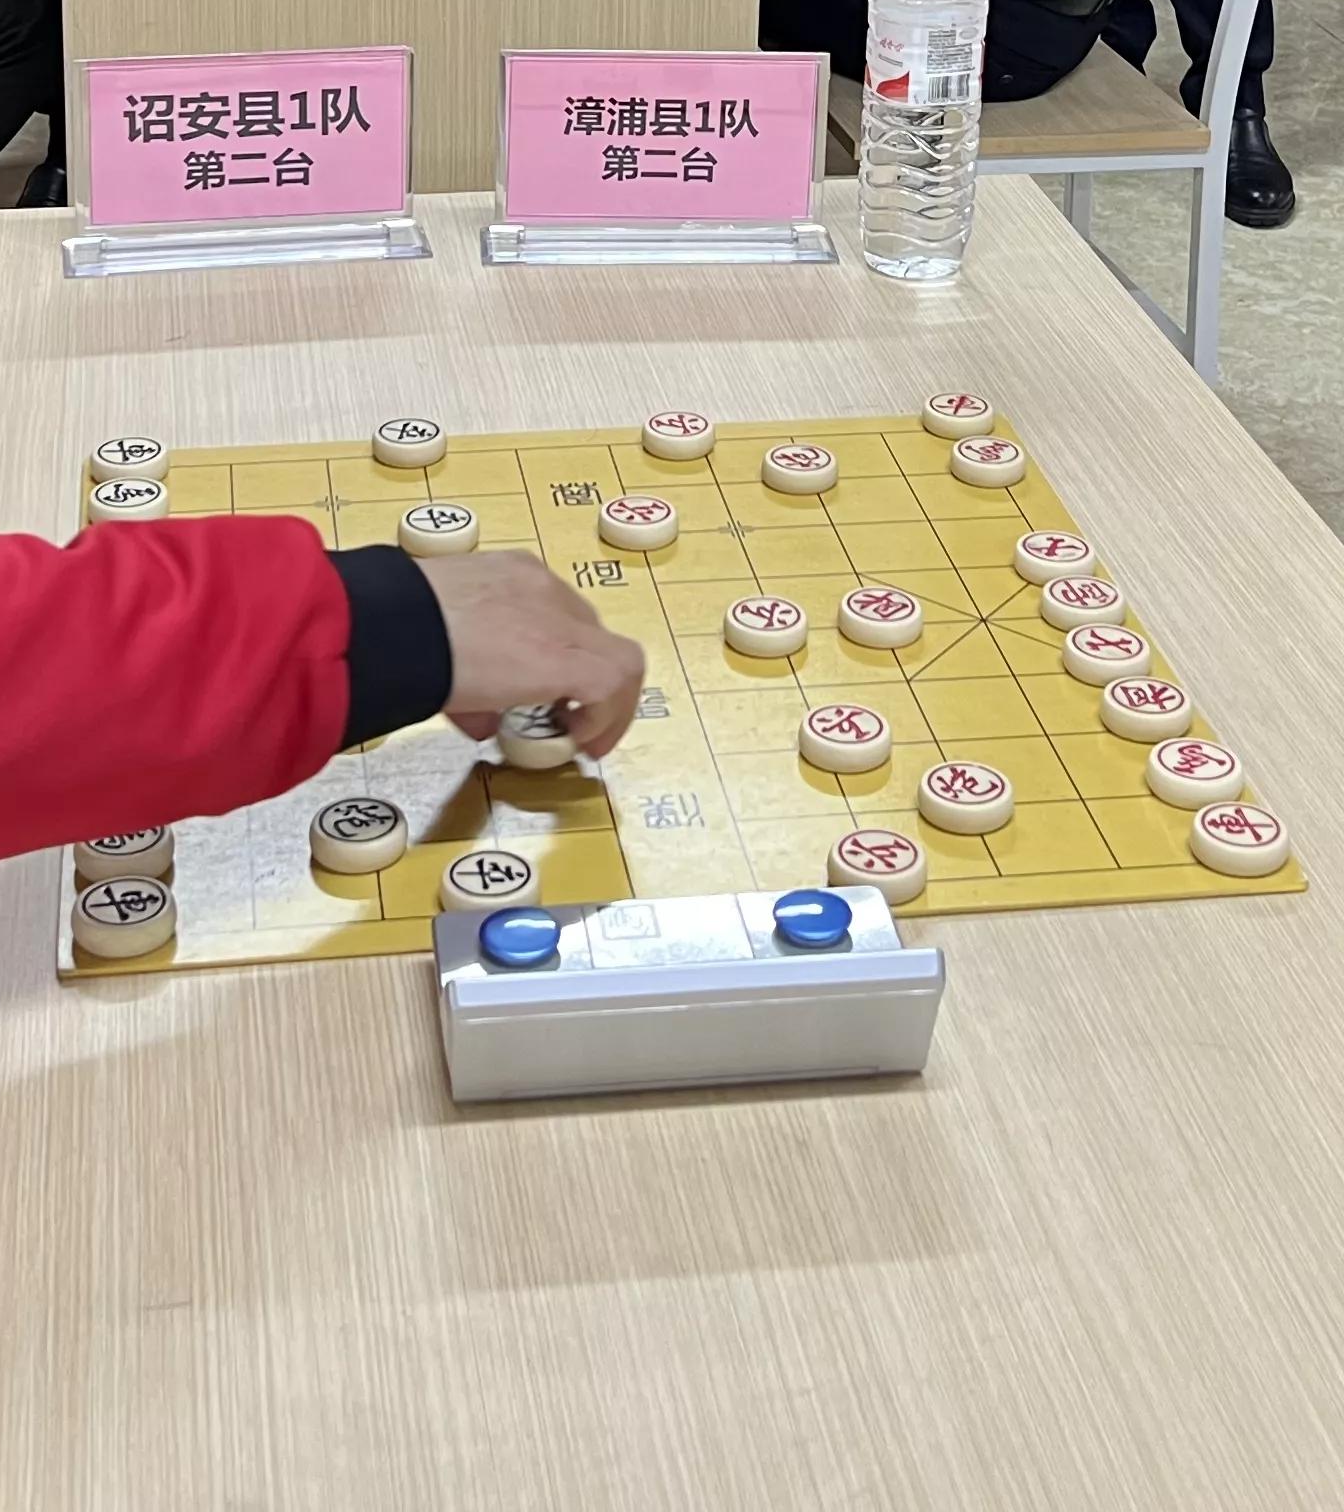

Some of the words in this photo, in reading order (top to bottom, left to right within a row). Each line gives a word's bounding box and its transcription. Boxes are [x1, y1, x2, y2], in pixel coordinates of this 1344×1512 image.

[123, 86, 371, 143] 诏安县1队
[563, 96, 759, 138] 漳浦县1队
[183, 148, 314, 190] 第二台
[602, 145, 718, 182] 第二台
[87, 880, 161, 922] 車
